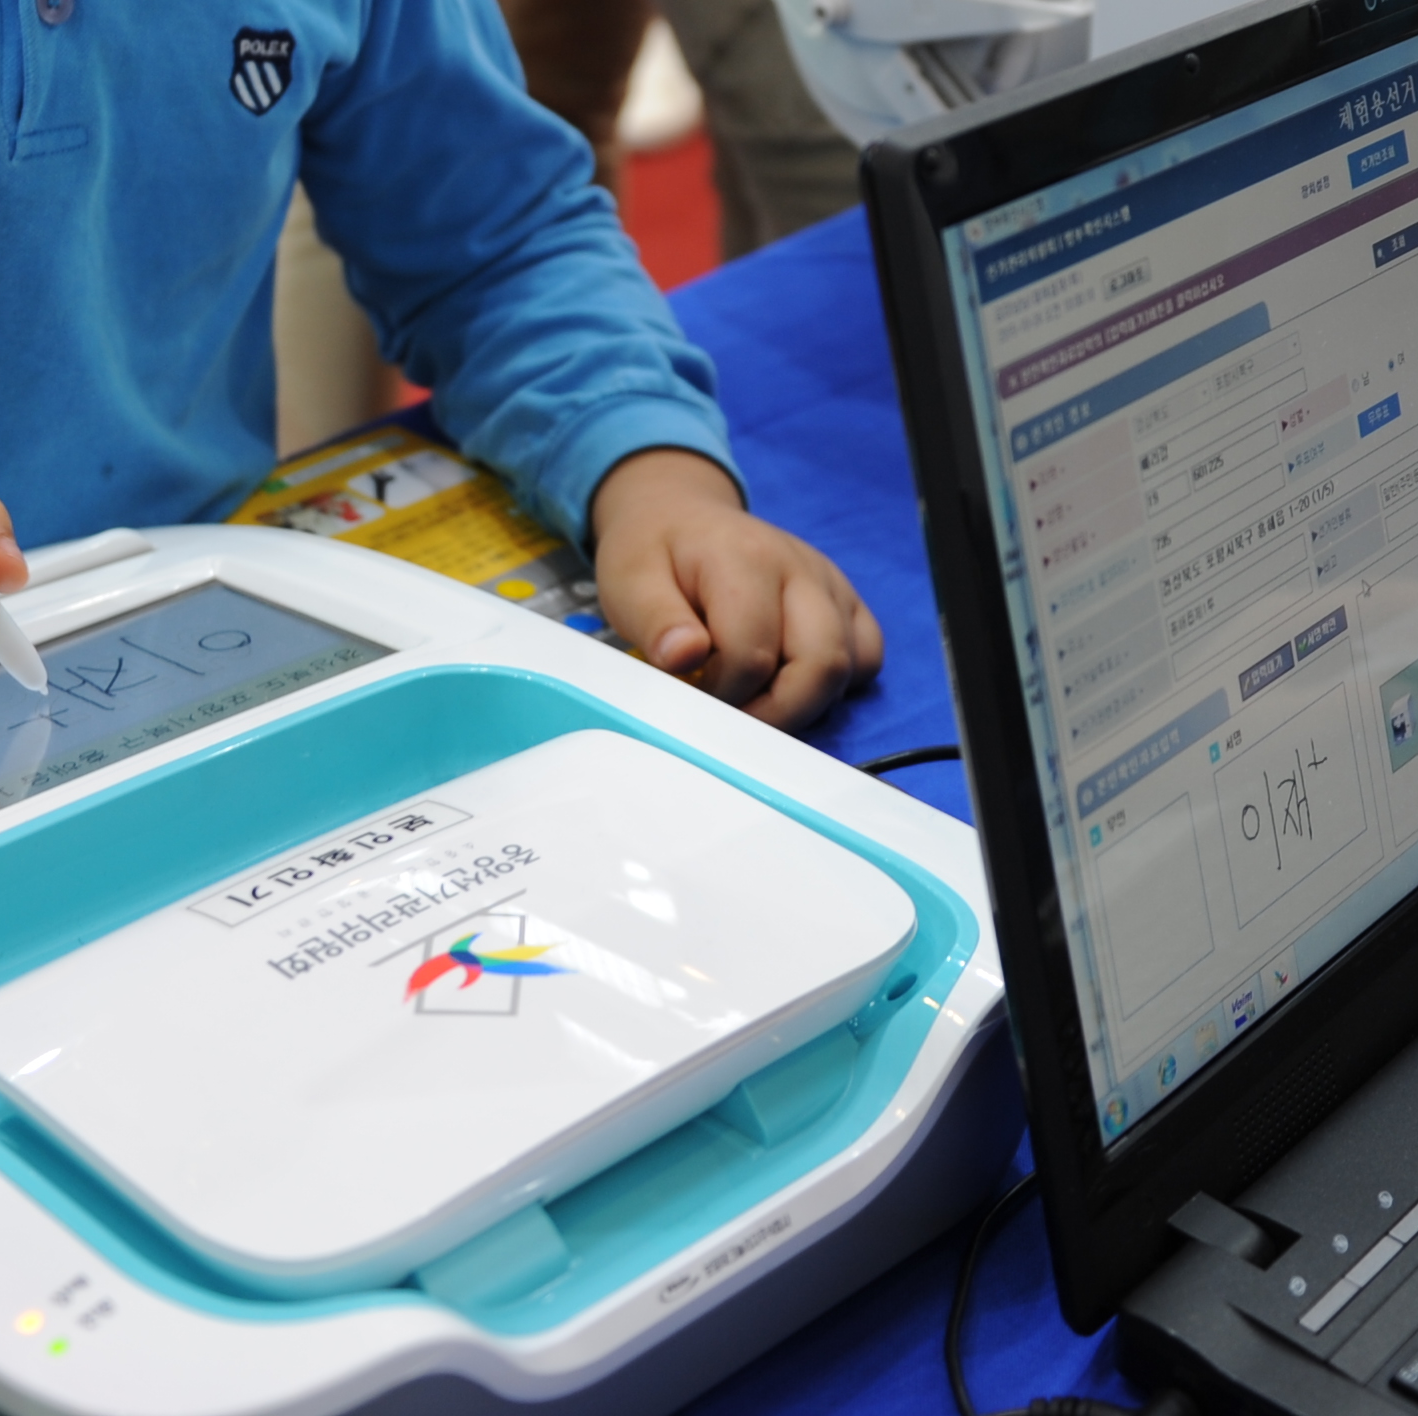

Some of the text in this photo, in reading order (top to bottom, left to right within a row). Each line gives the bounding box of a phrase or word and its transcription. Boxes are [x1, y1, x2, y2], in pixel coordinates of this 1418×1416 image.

[1337, 78, 1416, 131] 체험용선거
[1191, 454, 1224, 483] 601225
[1160, 560, 1201, 596] 경상북도
[1205, 529, 1254, 568] 포항시북구
[1288, 494, 1310, 517] 1-20
[1311, 478, 1335, 505] (1/5)
[253, 648, 363, 692] 경상북도
[1251, 652, 1283, 684] 입력대기
[110, 691, 254, 748] 포항시북구
[1224, 727, 1242, 753] 서명
[227, 814, 434, 908] 본인확인기
[266, 843, 541, 981] 중앙선거관리위원회
